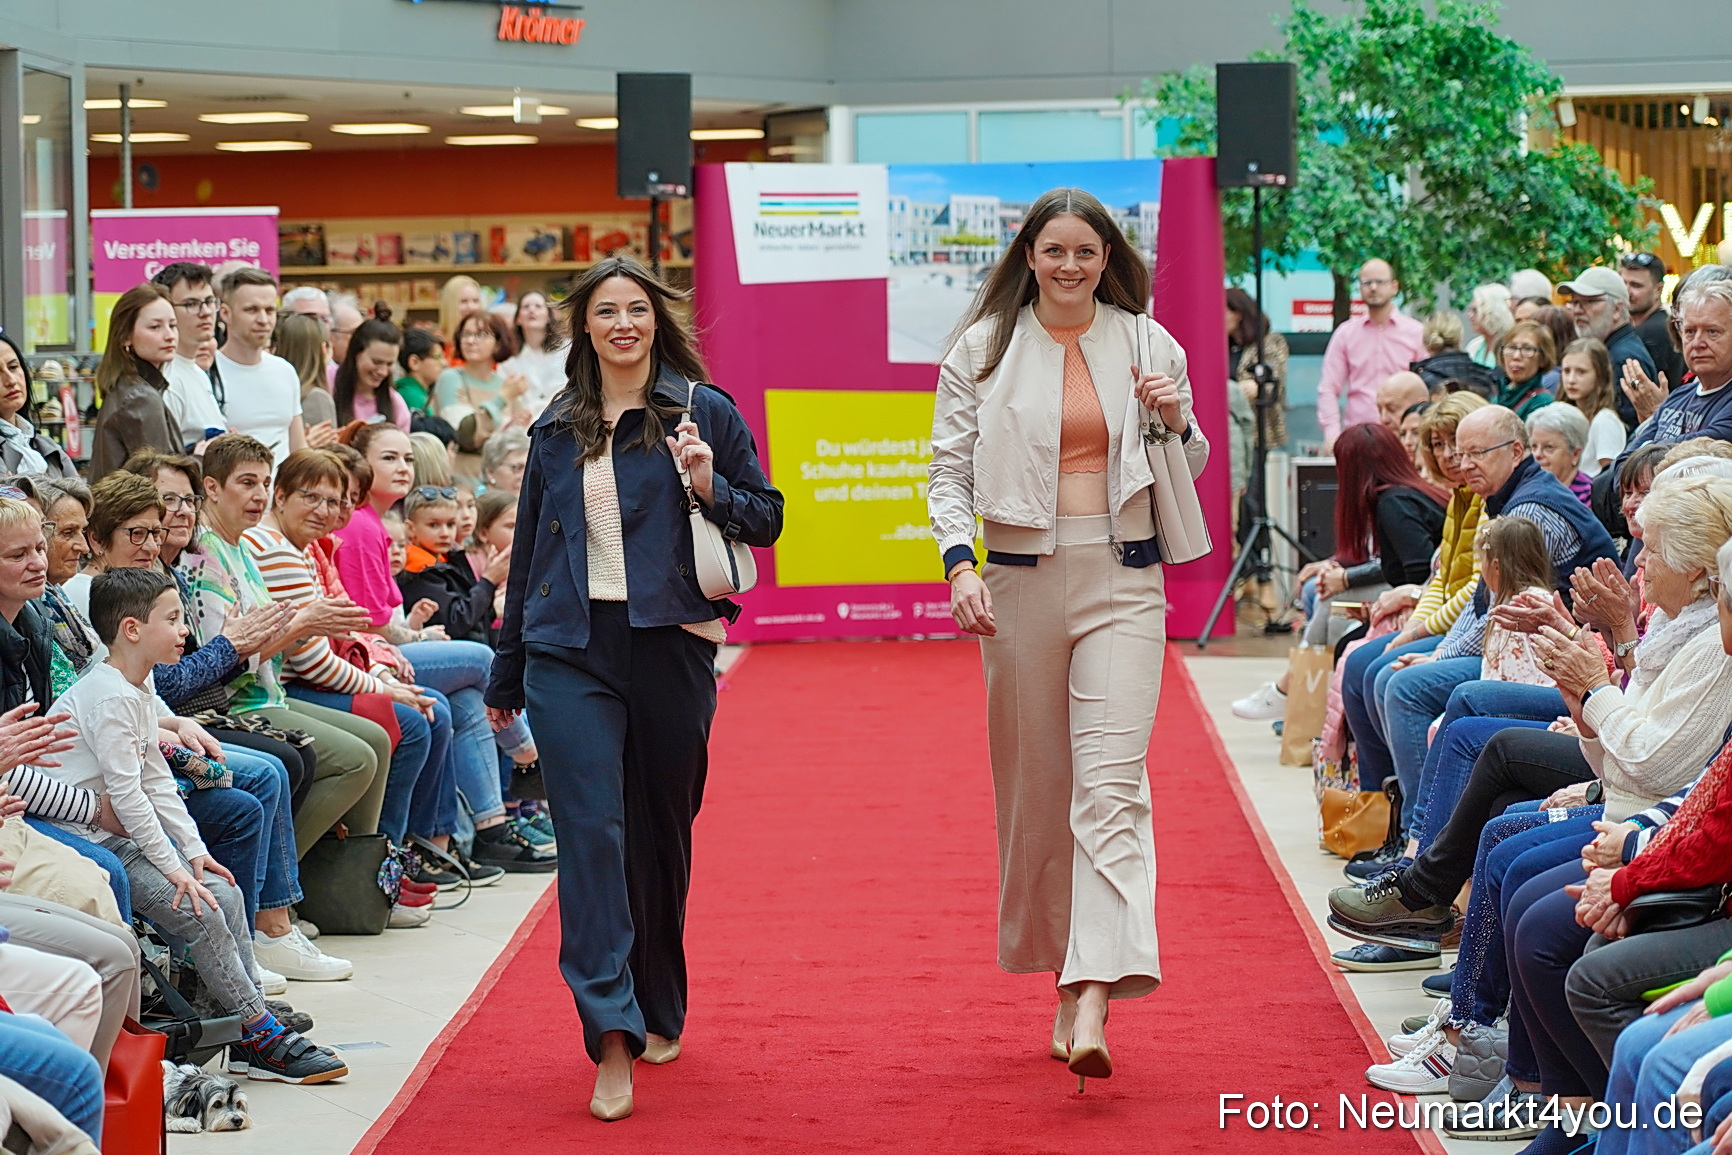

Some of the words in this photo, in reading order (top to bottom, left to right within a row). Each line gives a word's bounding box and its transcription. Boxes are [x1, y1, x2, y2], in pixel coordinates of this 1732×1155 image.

[498, 6, 586, 44] Krömer
[754, 221, 866, 237] NeuerMarkt
[103, 239, 227, 260] Verschenken
[228, 237, 260, 258] Sie
[815, 439, 841, 457] Du
[842, 437, 916, 457] würdest
[800, 461, 864, 480] Schuhe
[814, 483, 849, 502] und
[851, 481, 913, 501] deinen
